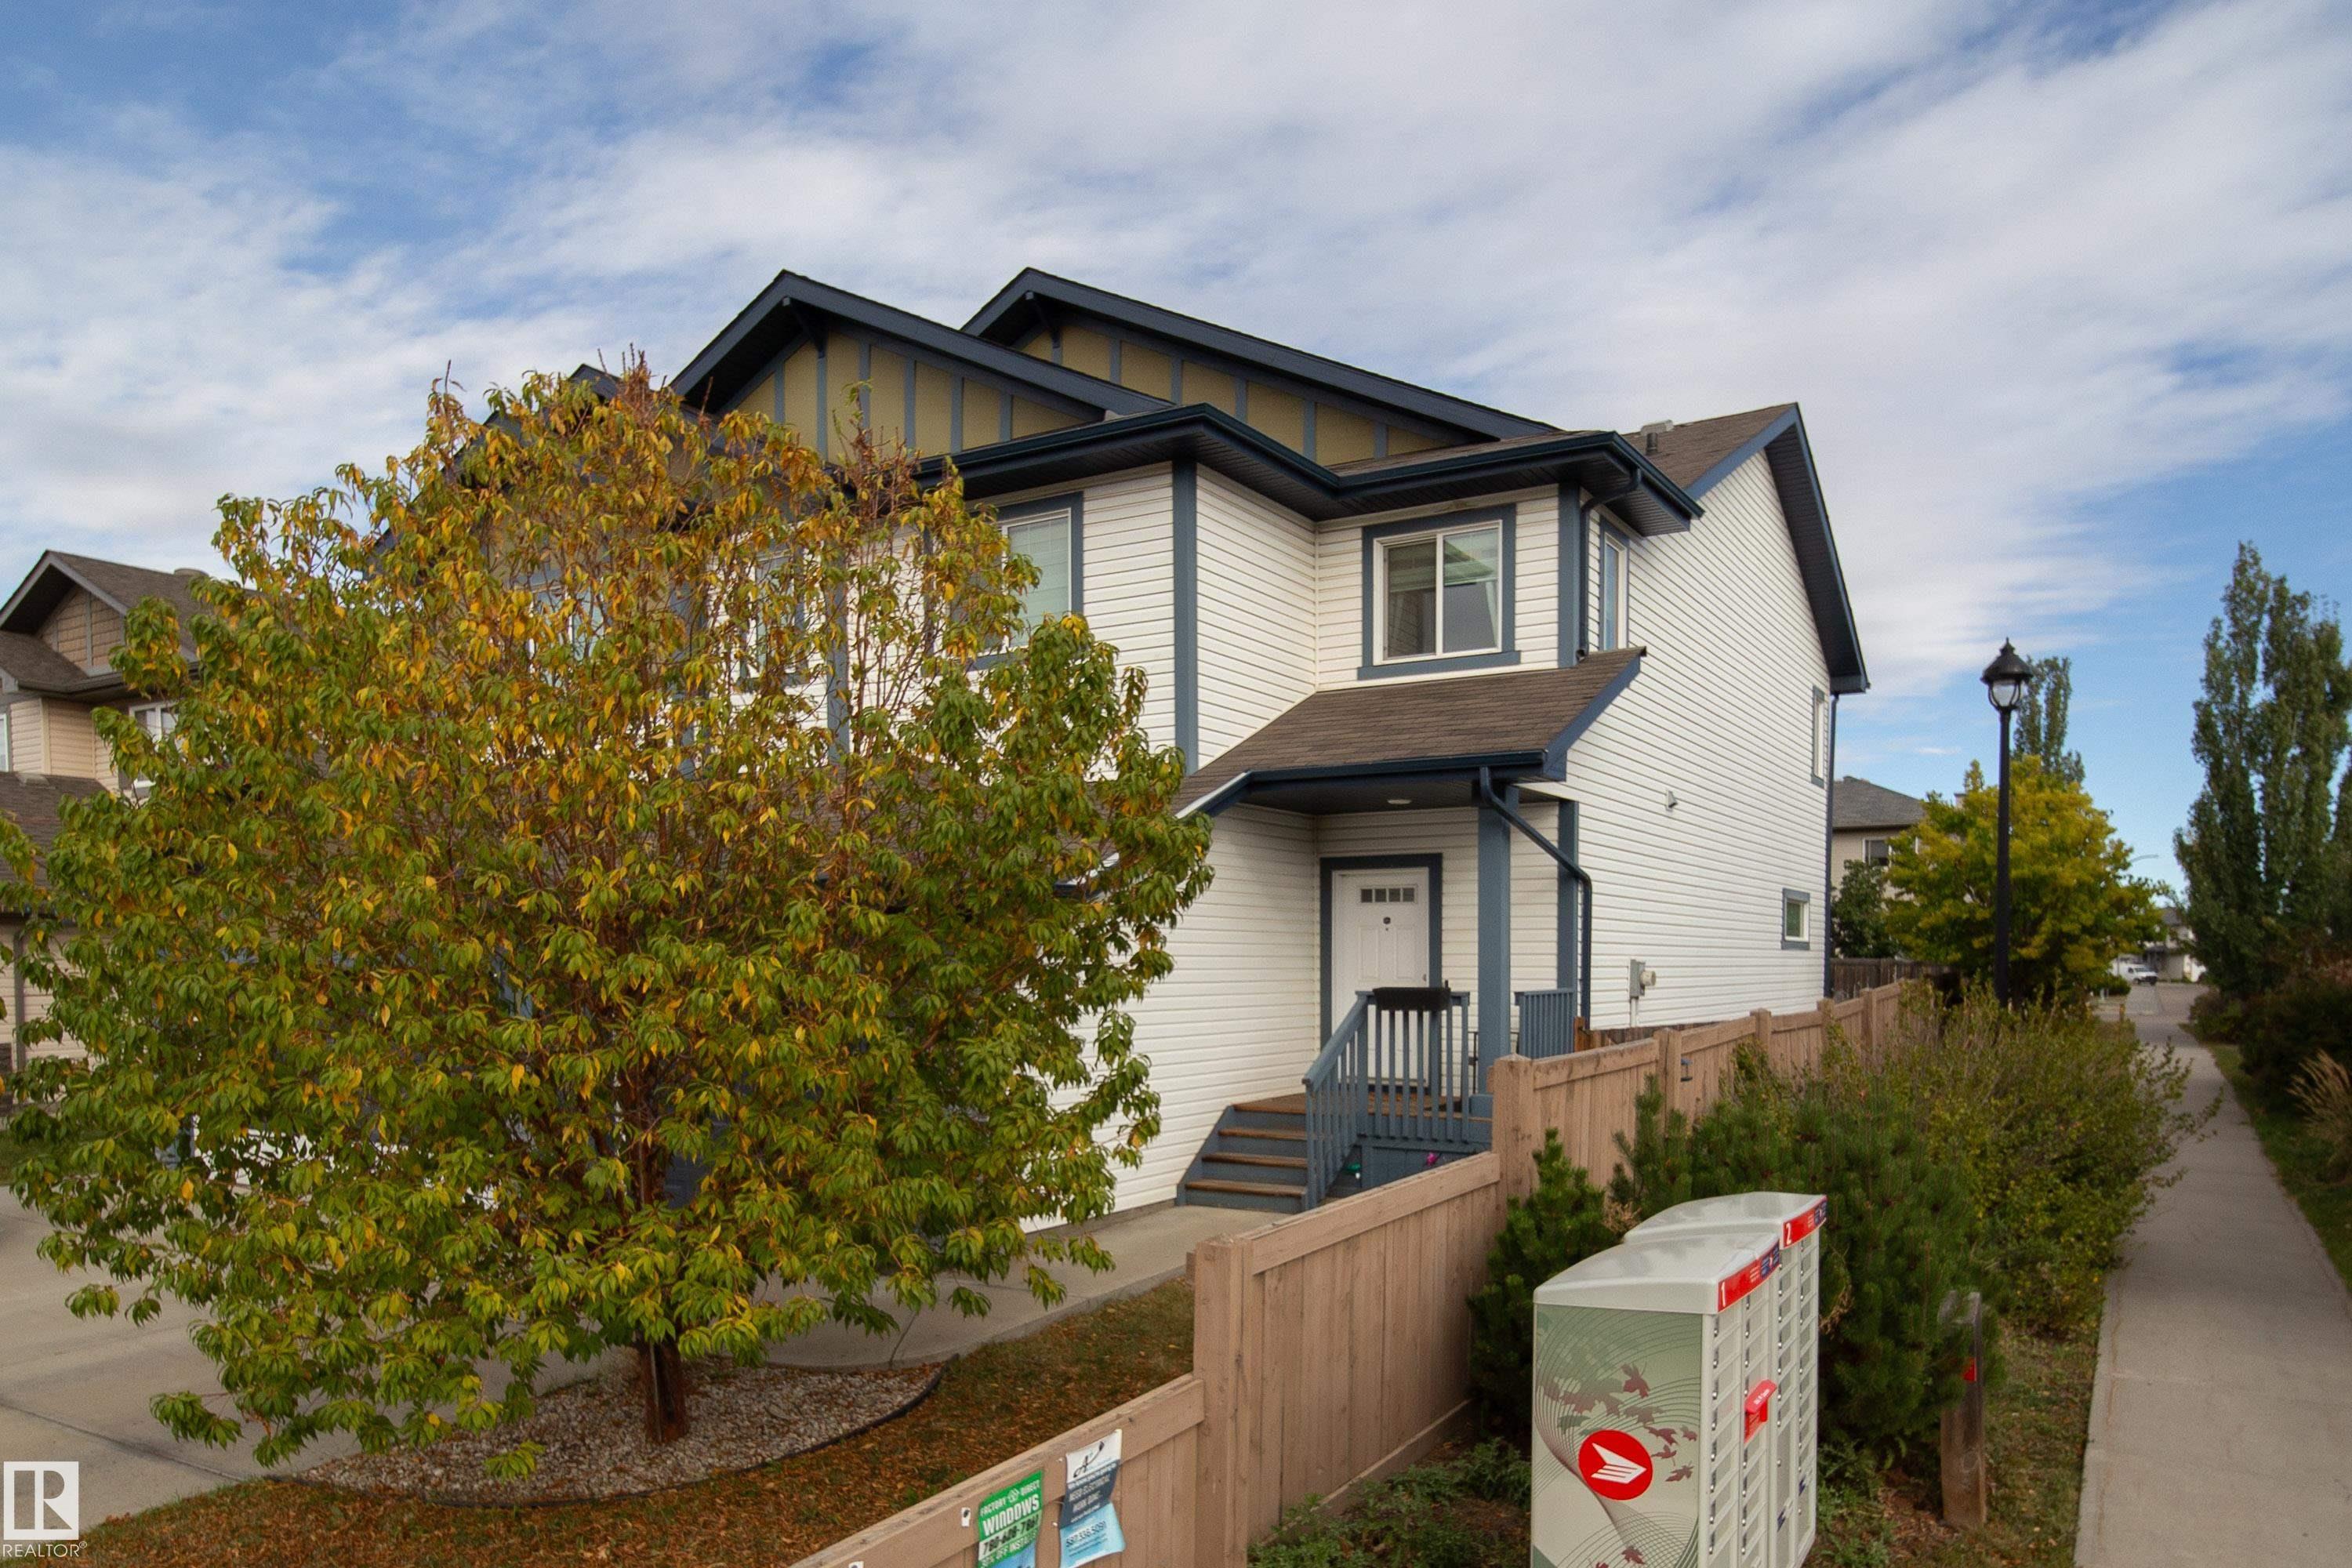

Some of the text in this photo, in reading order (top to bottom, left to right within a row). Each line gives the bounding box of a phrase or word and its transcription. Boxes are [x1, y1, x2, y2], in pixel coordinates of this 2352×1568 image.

[1785, 1221, 1792, 1246] 2
[1721, 1281, 1726, 1308] 1
[979, 1497, 1007, 1517] FACTORY
[982, 1494, 1040, 1537] WINDOWS
